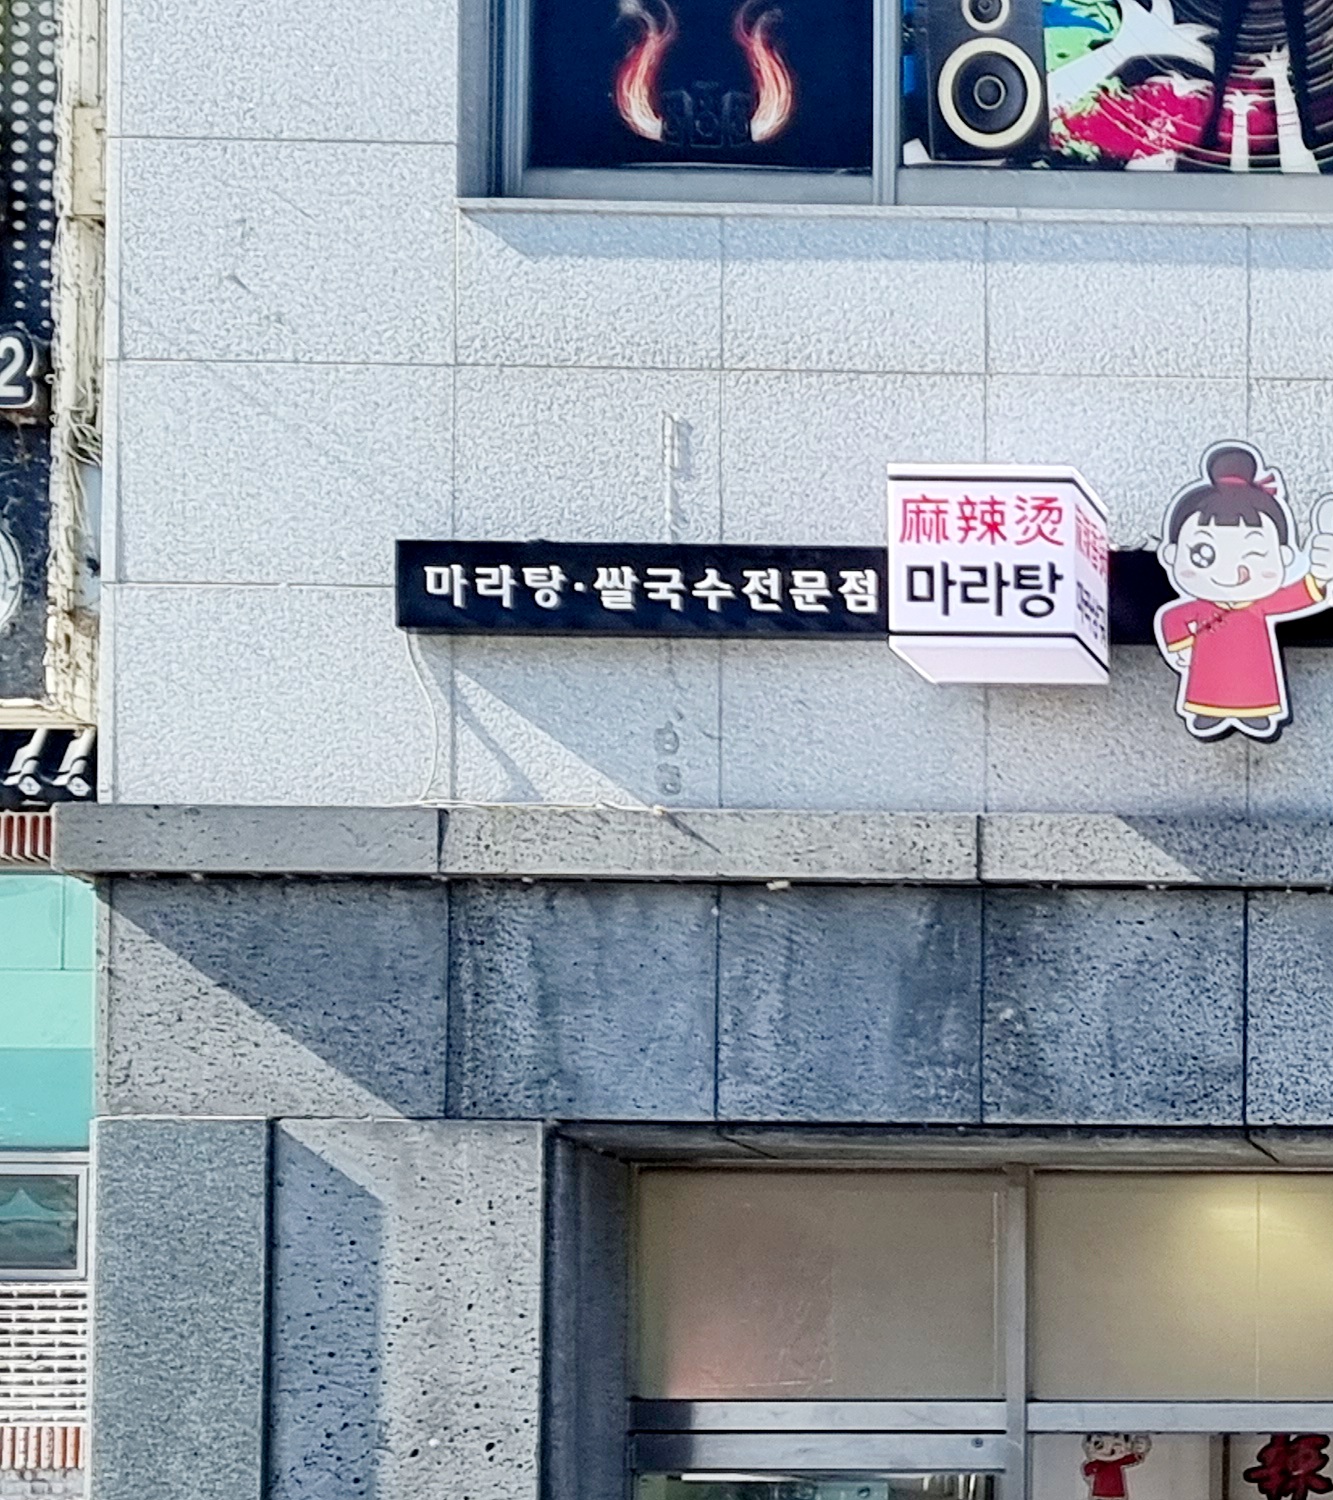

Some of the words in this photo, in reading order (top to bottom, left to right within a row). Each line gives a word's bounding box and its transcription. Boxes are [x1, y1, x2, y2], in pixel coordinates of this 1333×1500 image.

[900, 495, 1064, 547] 麻辣烫
[905, 561, 1063, 617] 마라탕
